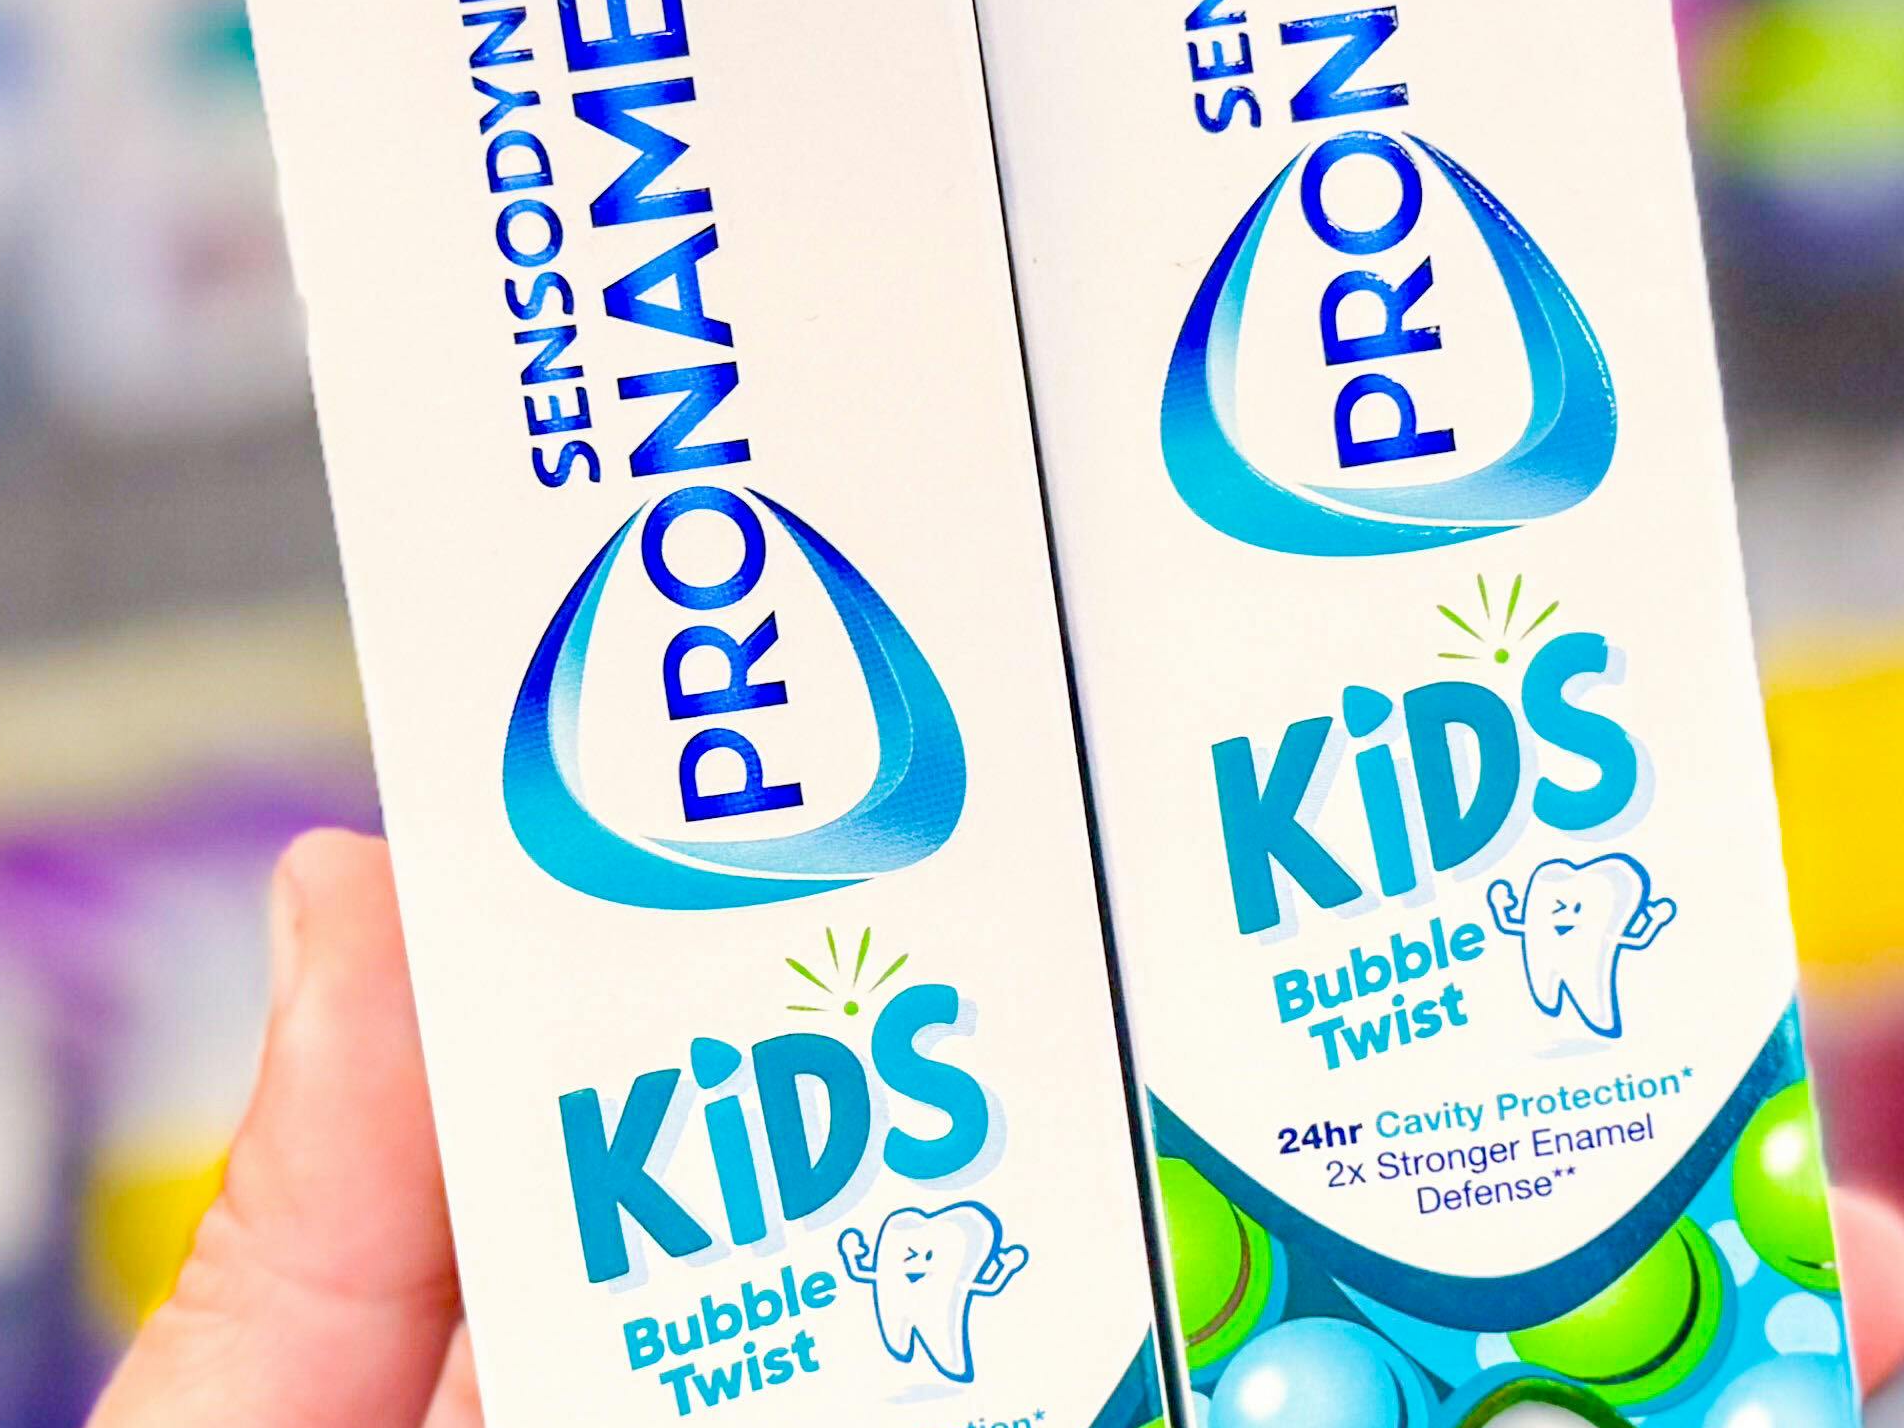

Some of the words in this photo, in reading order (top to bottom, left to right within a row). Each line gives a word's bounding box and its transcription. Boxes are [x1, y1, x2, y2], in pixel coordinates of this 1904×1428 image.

[1272, 918, 1487, 1024] Bubble
[1309, 983, 1469, 1071] Twist
[1277, 1119, 1364, 1155] 24hr
[1375, 1099, 1484, 1141] Cavity
[1326, 1160, 1367, 1188] 2x
[1377, 1138, 1521, 1182] Stronger
[1533, 1112, 1655, 1155] Enamel
[622, 1265, 838, 1370] Bubble
[659, 1329, 821, 1417] Twist
